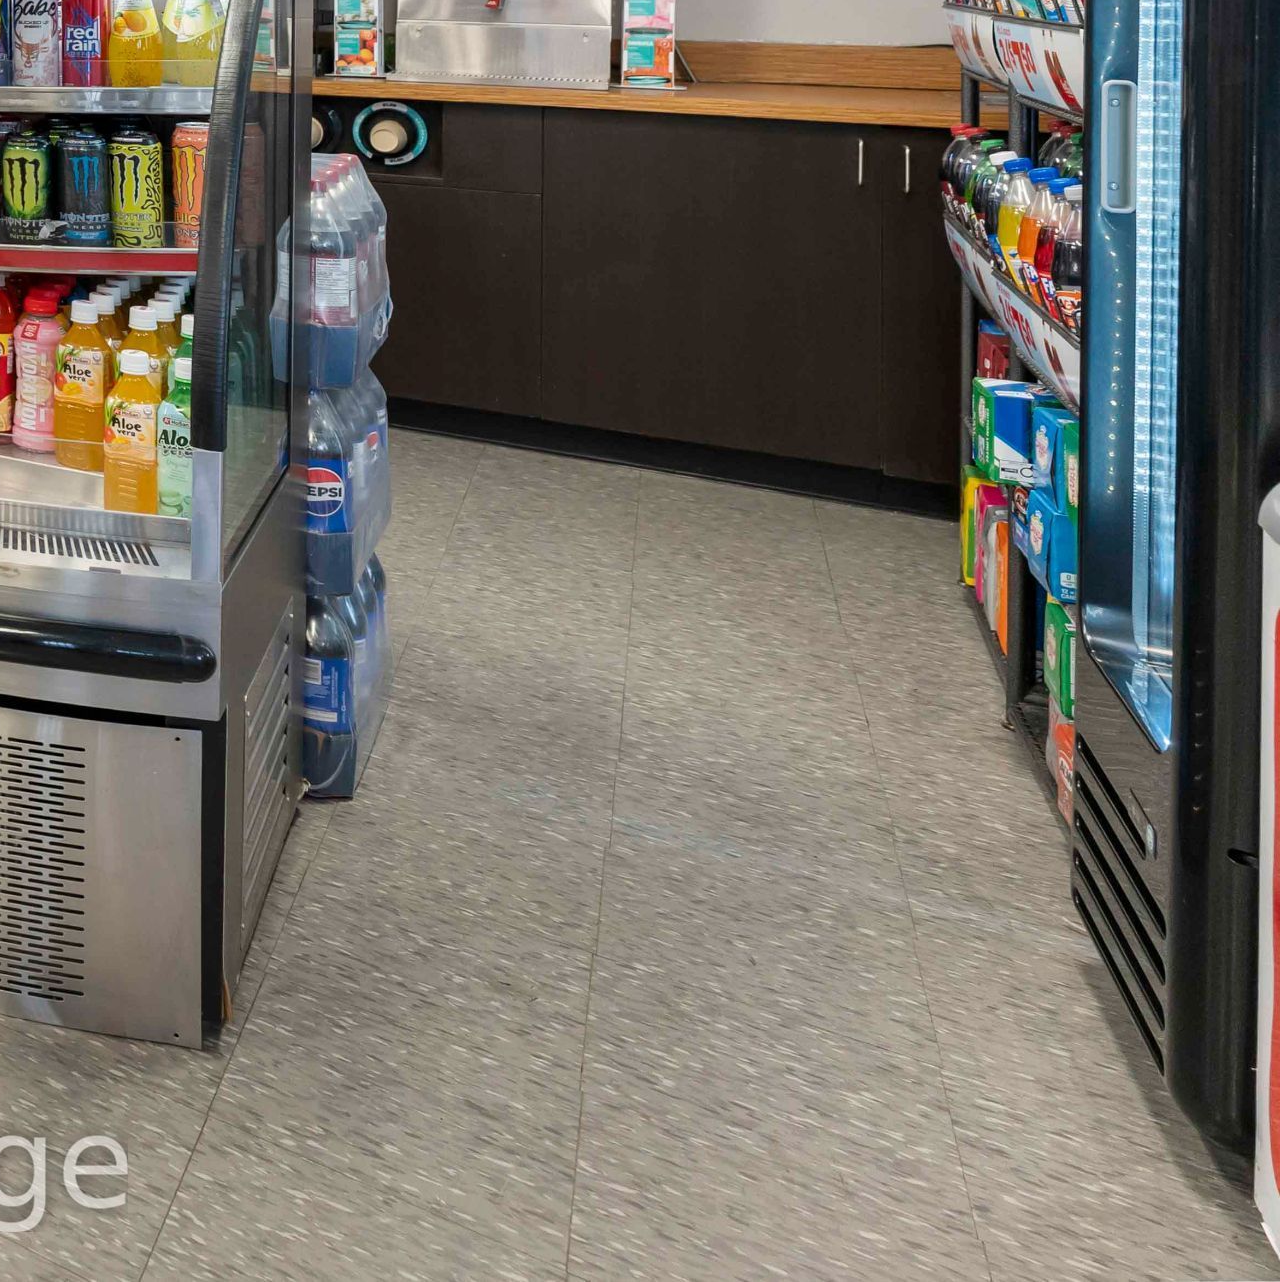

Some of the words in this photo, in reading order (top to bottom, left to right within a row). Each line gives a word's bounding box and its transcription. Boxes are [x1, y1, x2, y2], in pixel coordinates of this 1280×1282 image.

[66, 24, 98, 41] red
[65, 37, 99, 52] rain
[9, 233, 41, 241] NITRO
[63, 363, 92, 377] Aloe
[68, 374, 86, 382] vera
[20, 342, 37, 431] HYDRATION
[112, 416, 142, 432] Aloe
[117, 429, 136, 437] vera
[158, 429, 190, 446] Alo
[307, 486, 342, 498] EPSI
